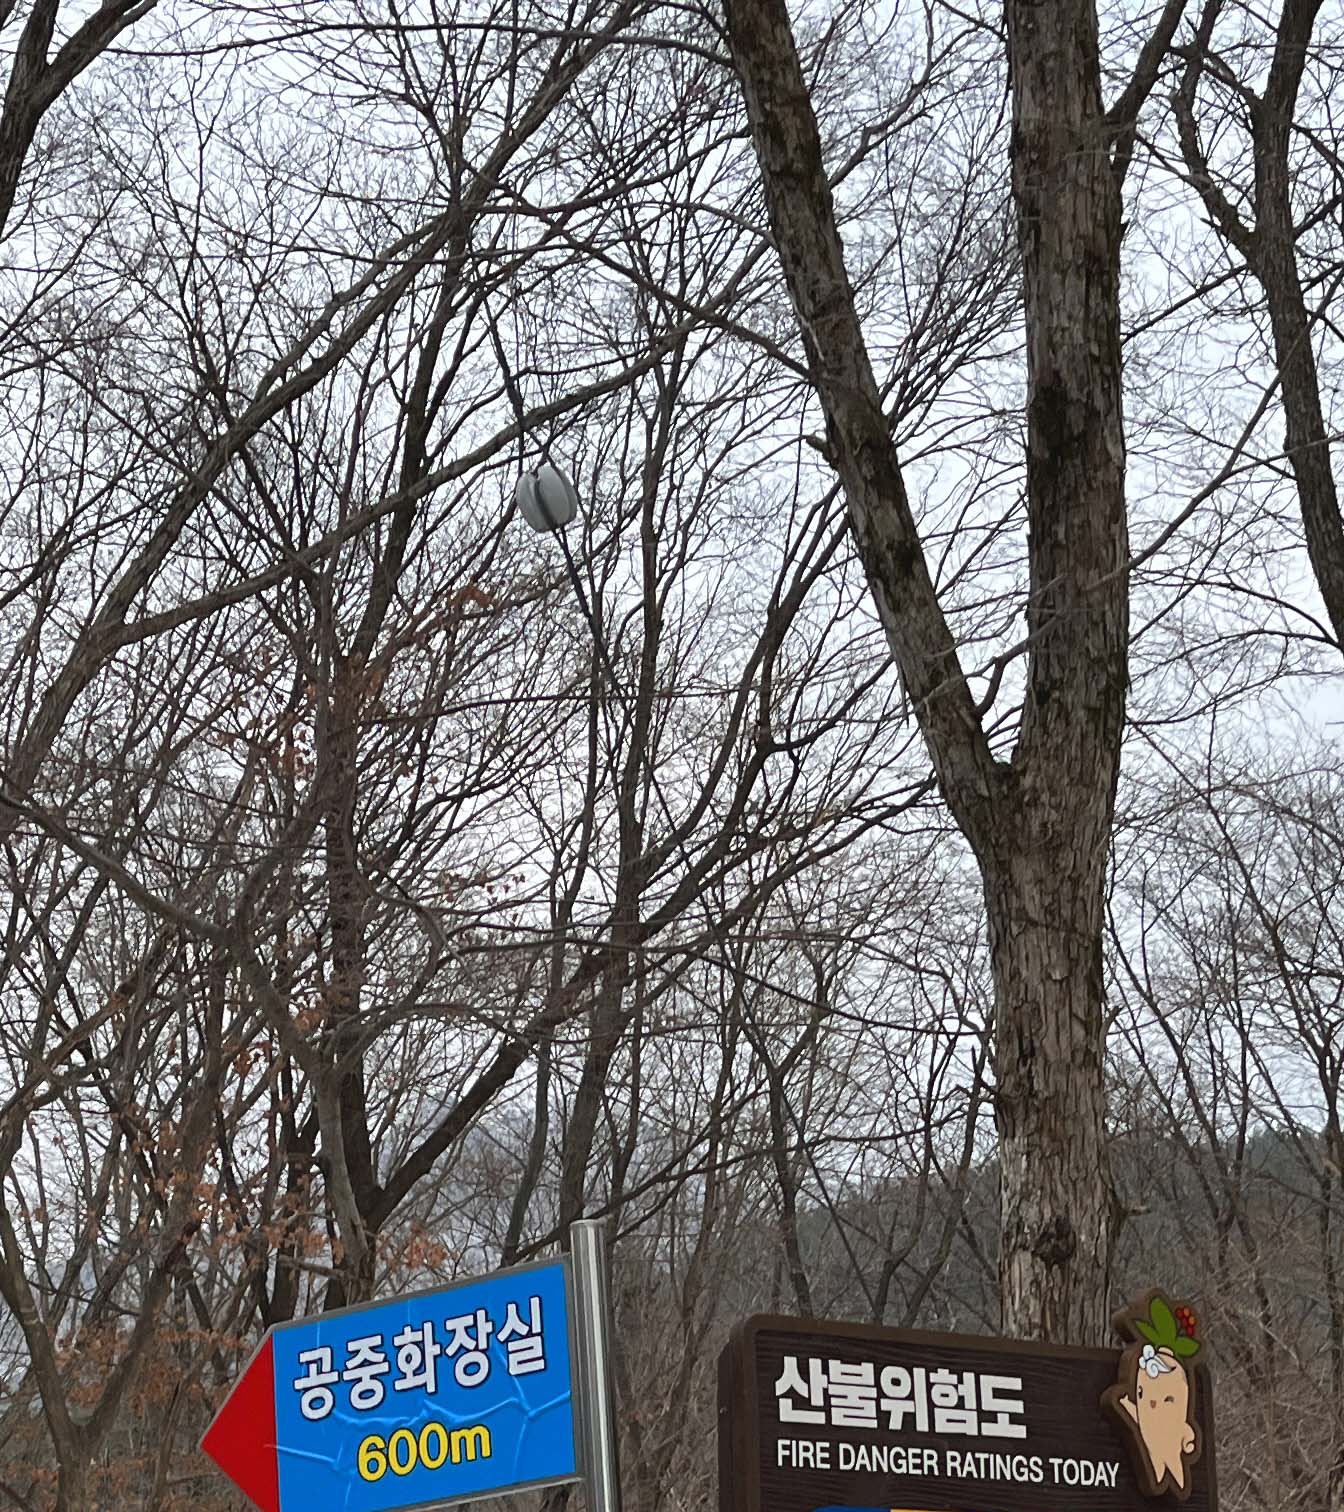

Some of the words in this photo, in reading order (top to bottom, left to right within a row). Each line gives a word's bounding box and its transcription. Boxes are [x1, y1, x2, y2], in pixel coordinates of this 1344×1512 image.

[293, 1295, 547, 1421] 공중화장실
[775, 1355, 1028, 1439] 산불위험도
[357, 1422, 492, 1482] 600m
[777, 1440, 830, 1469] FIRE
[838, 1443, 939, 1477] DANGER
[946, 1450, 1044, 1483] RATINGS
[1049, 1457, 1120, 1488] TODAY
